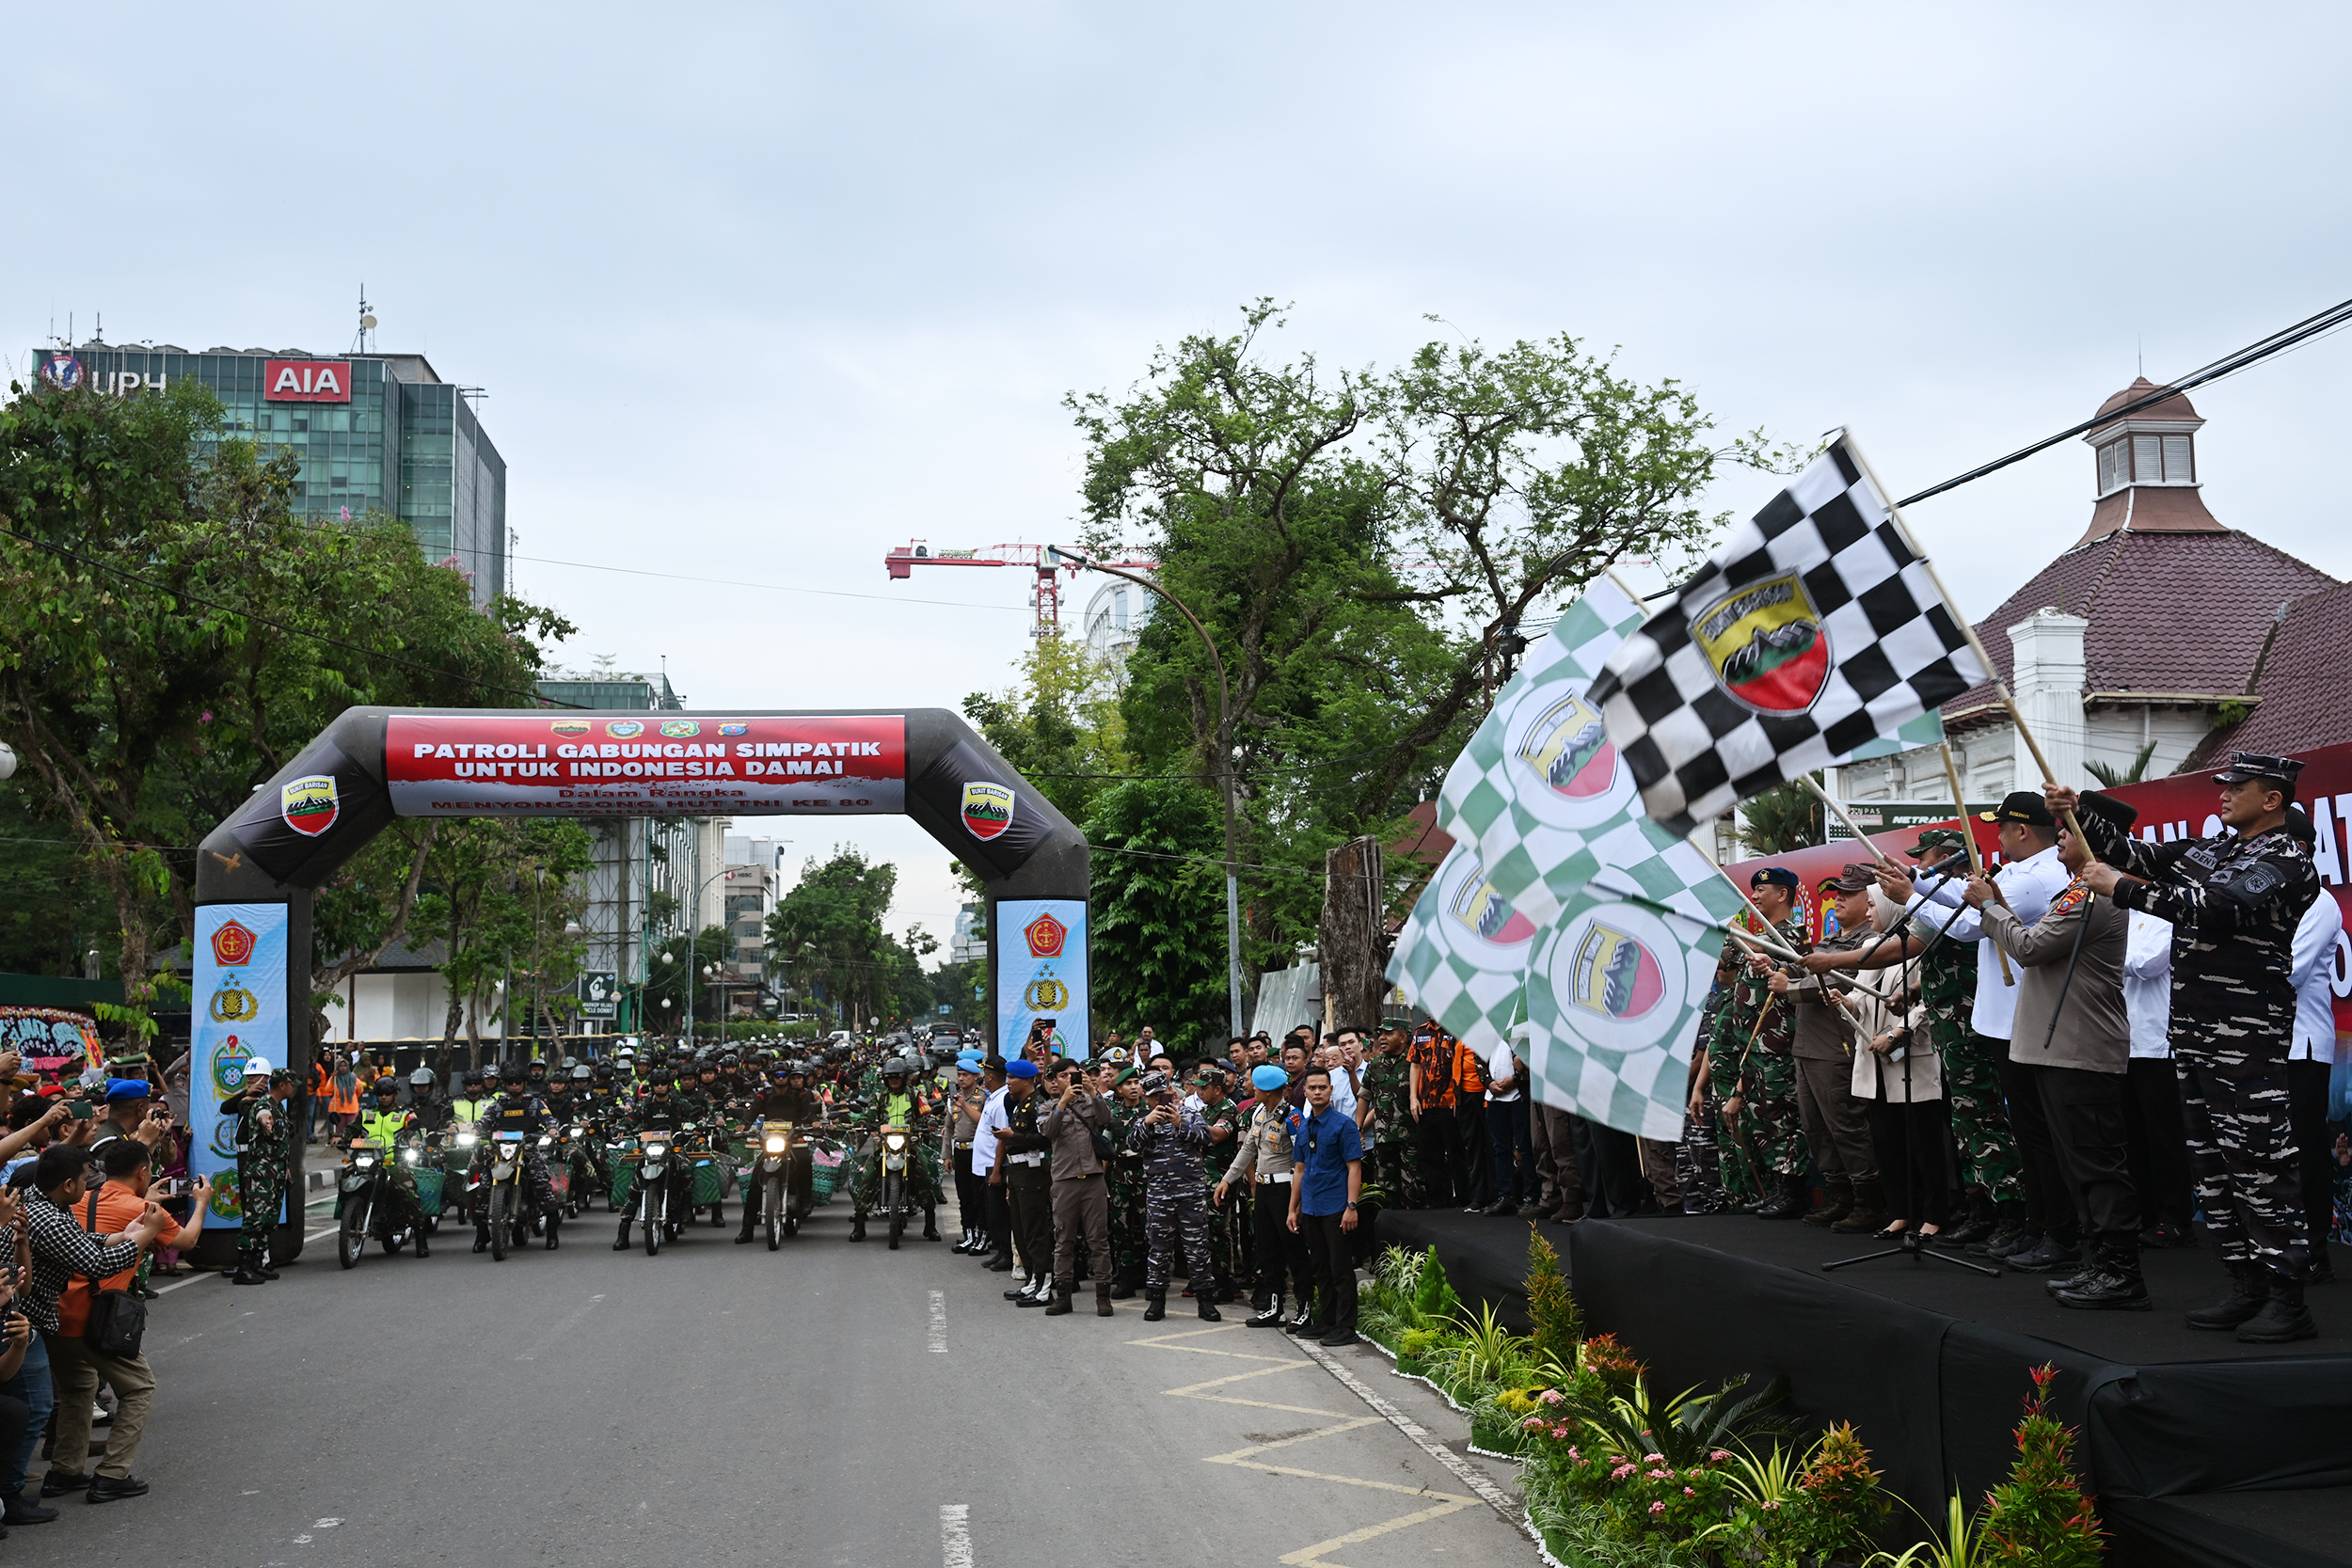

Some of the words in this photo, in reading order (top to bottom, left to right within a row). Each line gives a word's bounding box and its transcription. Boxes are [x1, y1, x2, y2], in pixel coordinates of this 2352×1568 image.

[91, 371, 167, 399] UPH
[273, 367, 342, 394] AIA
[414, 743, 547, 759] PATROLI
[556, 743, 726, 759] GABUNGAN
[736, 741, 882, 758] SIMPATIK
[454, 762, 560, 777] UNTUK
[569, 761, 736, 777] INDONESIA
[745, 760, 843, 776] DAMAI
[558, 789, 641, 799] Dalam
[649, 788, 745, 799] Rangka
[431, 800, 657, 809] MENYONGSONG
[666, 800, 722, 808] HUT
[734, 799, 781, 807] TNI
[791, 799, 833, 807] KE
[839, 799, 872, 807] 80
[1268, 1125, 1281, 1133] POLRI
